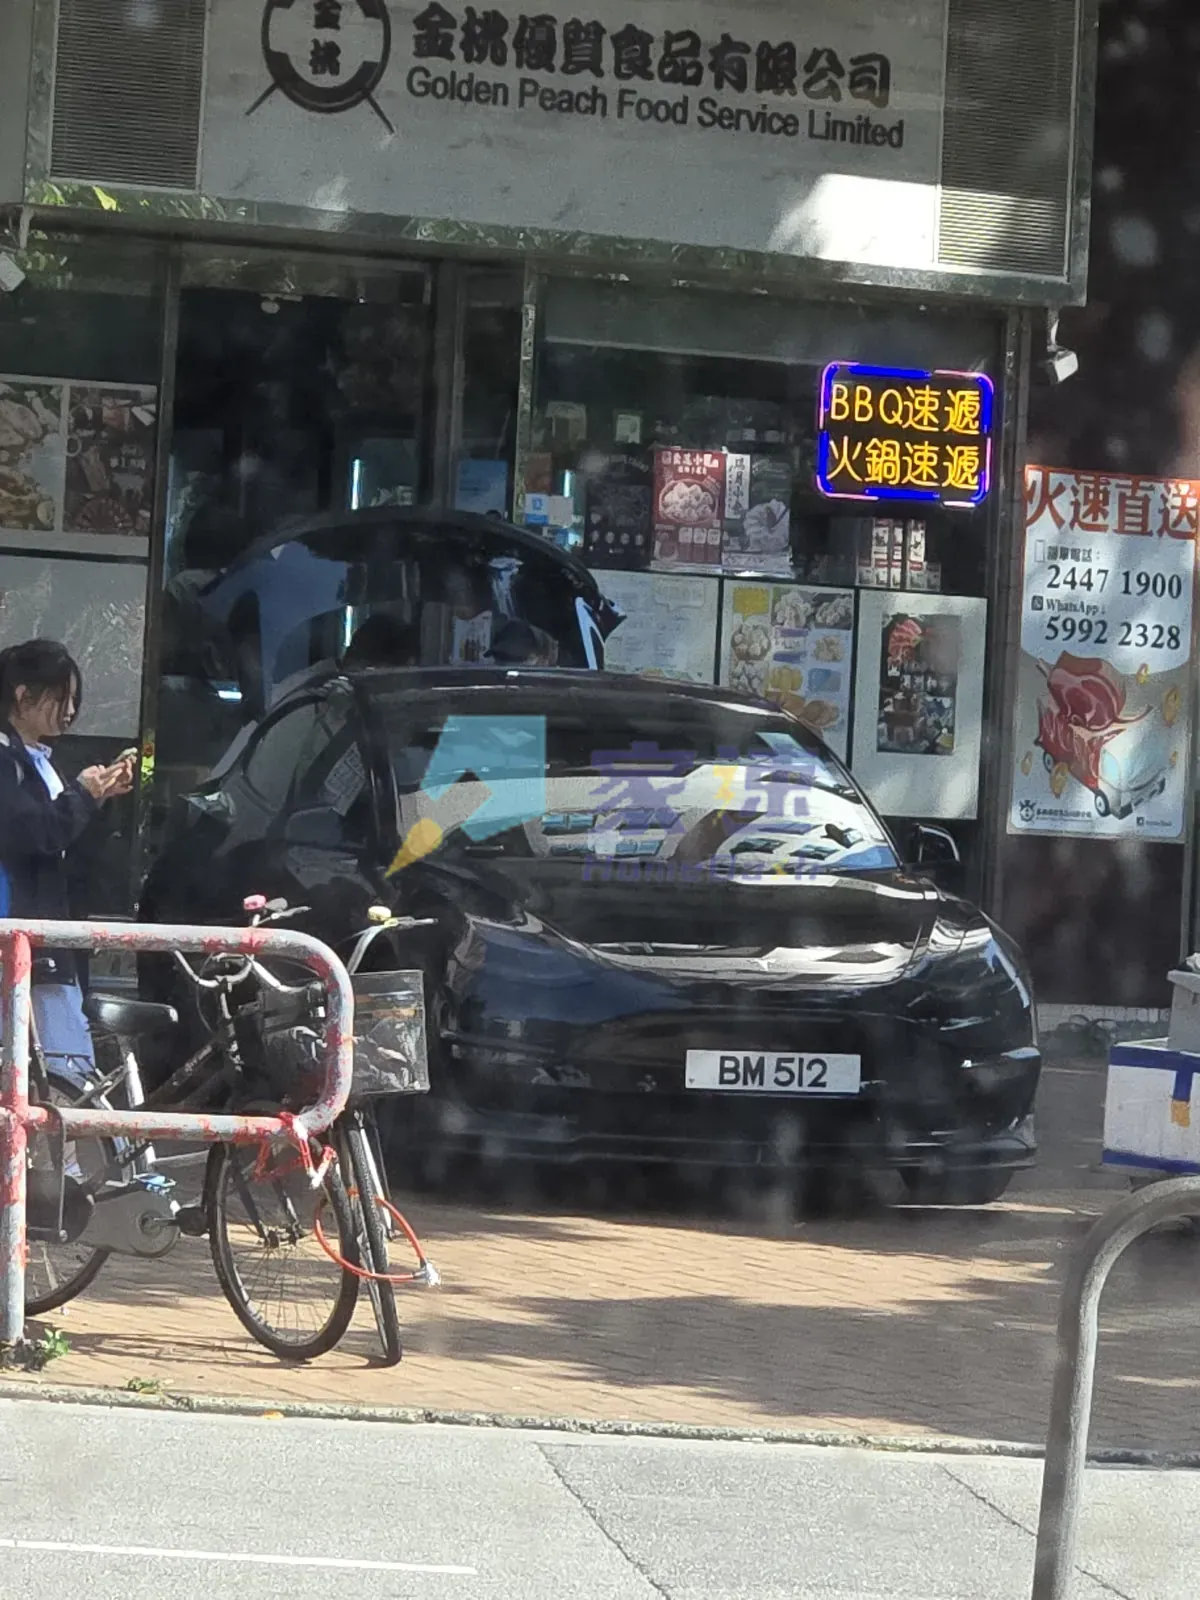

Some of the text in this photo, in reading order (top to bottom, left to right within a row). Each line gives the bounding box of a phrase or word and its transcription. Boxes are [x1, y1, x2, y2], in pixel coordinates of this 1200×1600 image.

[412, 1, 891, 108] 金桃優質食品有限公司
[406, 65, 904, 149] Golden Peach Food Service Limited
[830, 384, 980, 435] BBQ速遞
[826, 435, 980, 490] 火鍋速遞
[1024, 468, 1197, 540] 火速直送
[1047, 565, 1182, 599] 2447 1900
[1045, 615, 1181, 650] 5992 2328
[718, 1055, 828, 1088] BM 512
